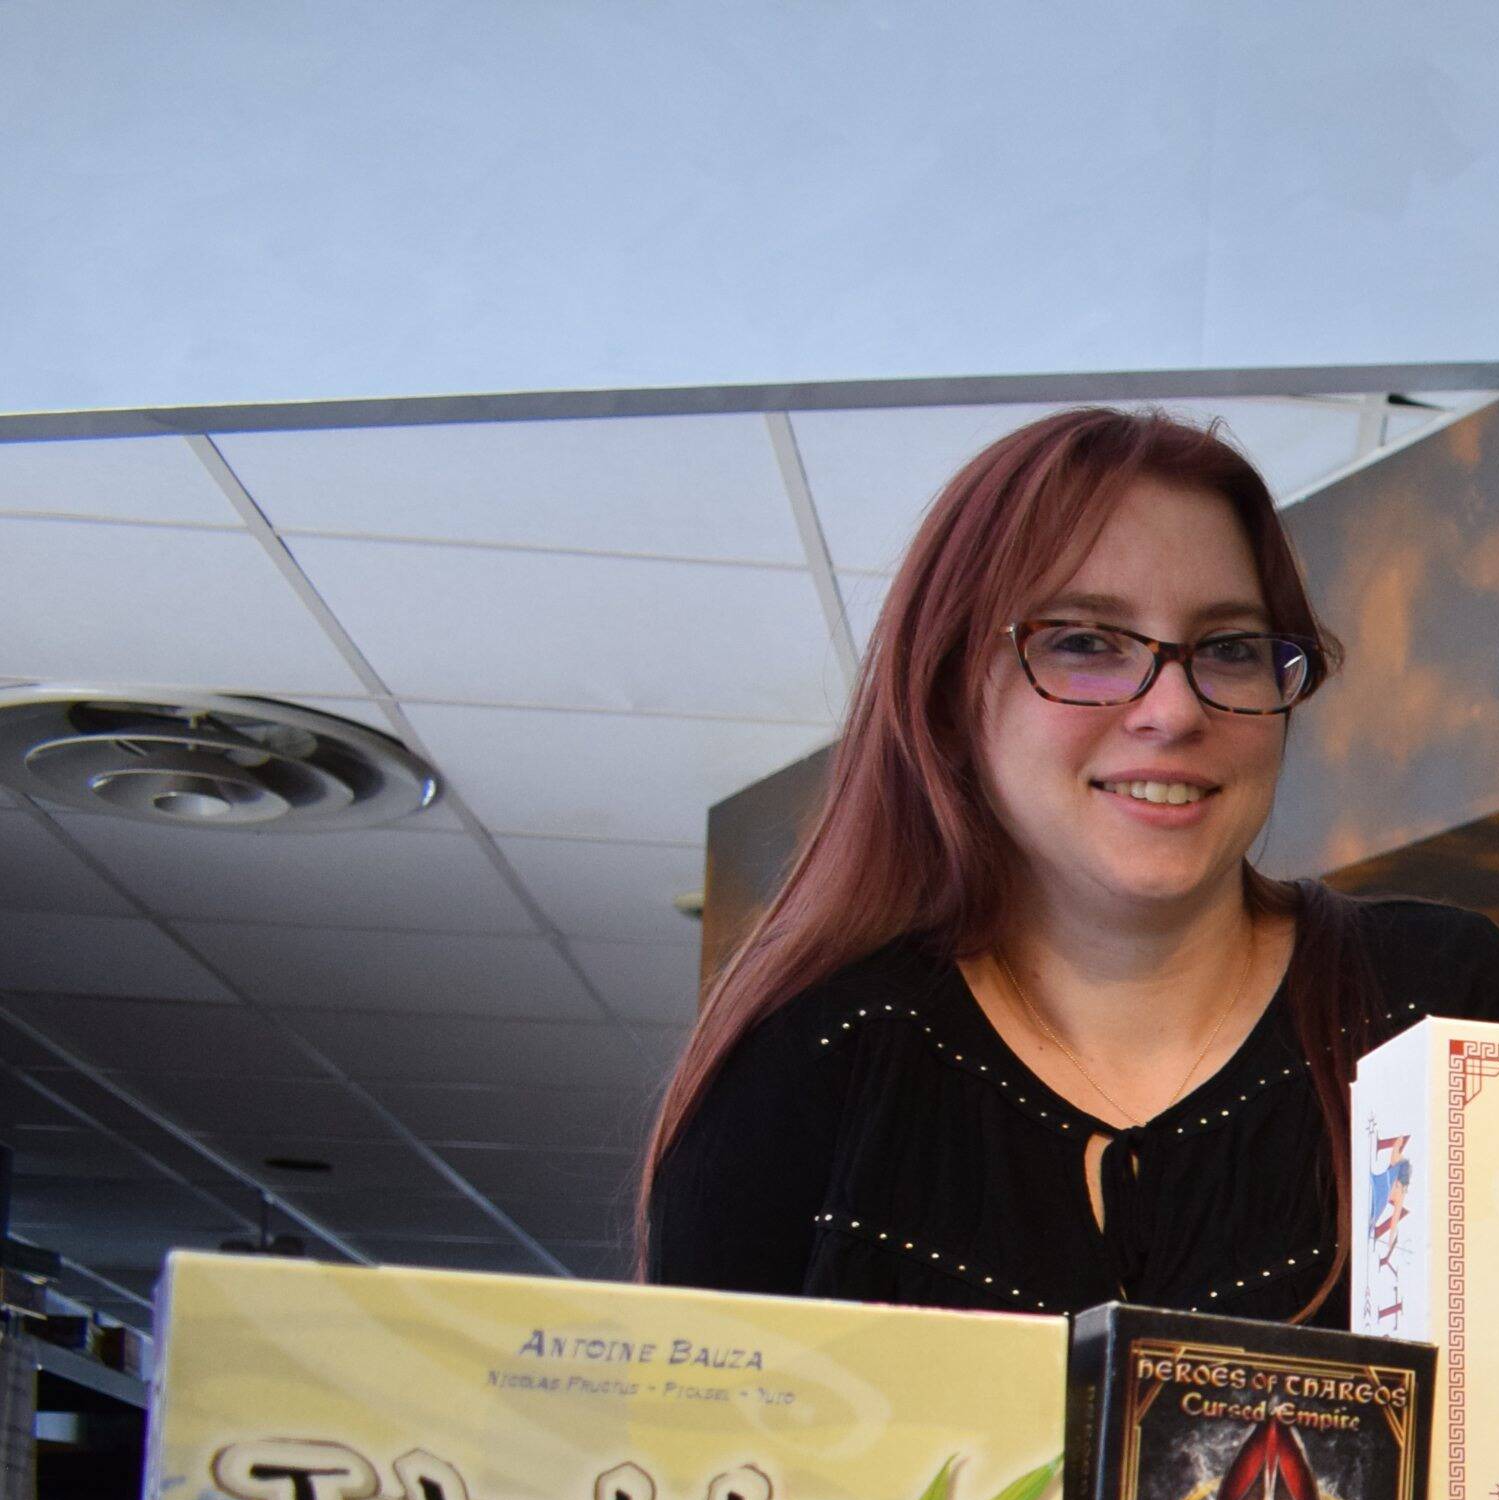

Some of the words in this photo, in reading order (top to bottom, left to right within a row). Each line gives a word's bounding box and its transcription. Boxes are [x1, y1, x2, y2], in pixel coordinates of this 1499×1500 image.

[518, 1328, 656, 1364] ANTOINE
[667, 1338, 764, 1371] BAUZA
[1136, 1358, 1247, 1389] HEROES
[1181, 1391, 1267, 1422] Cursed
[1274, 1401, 1361, 1432] Empire
